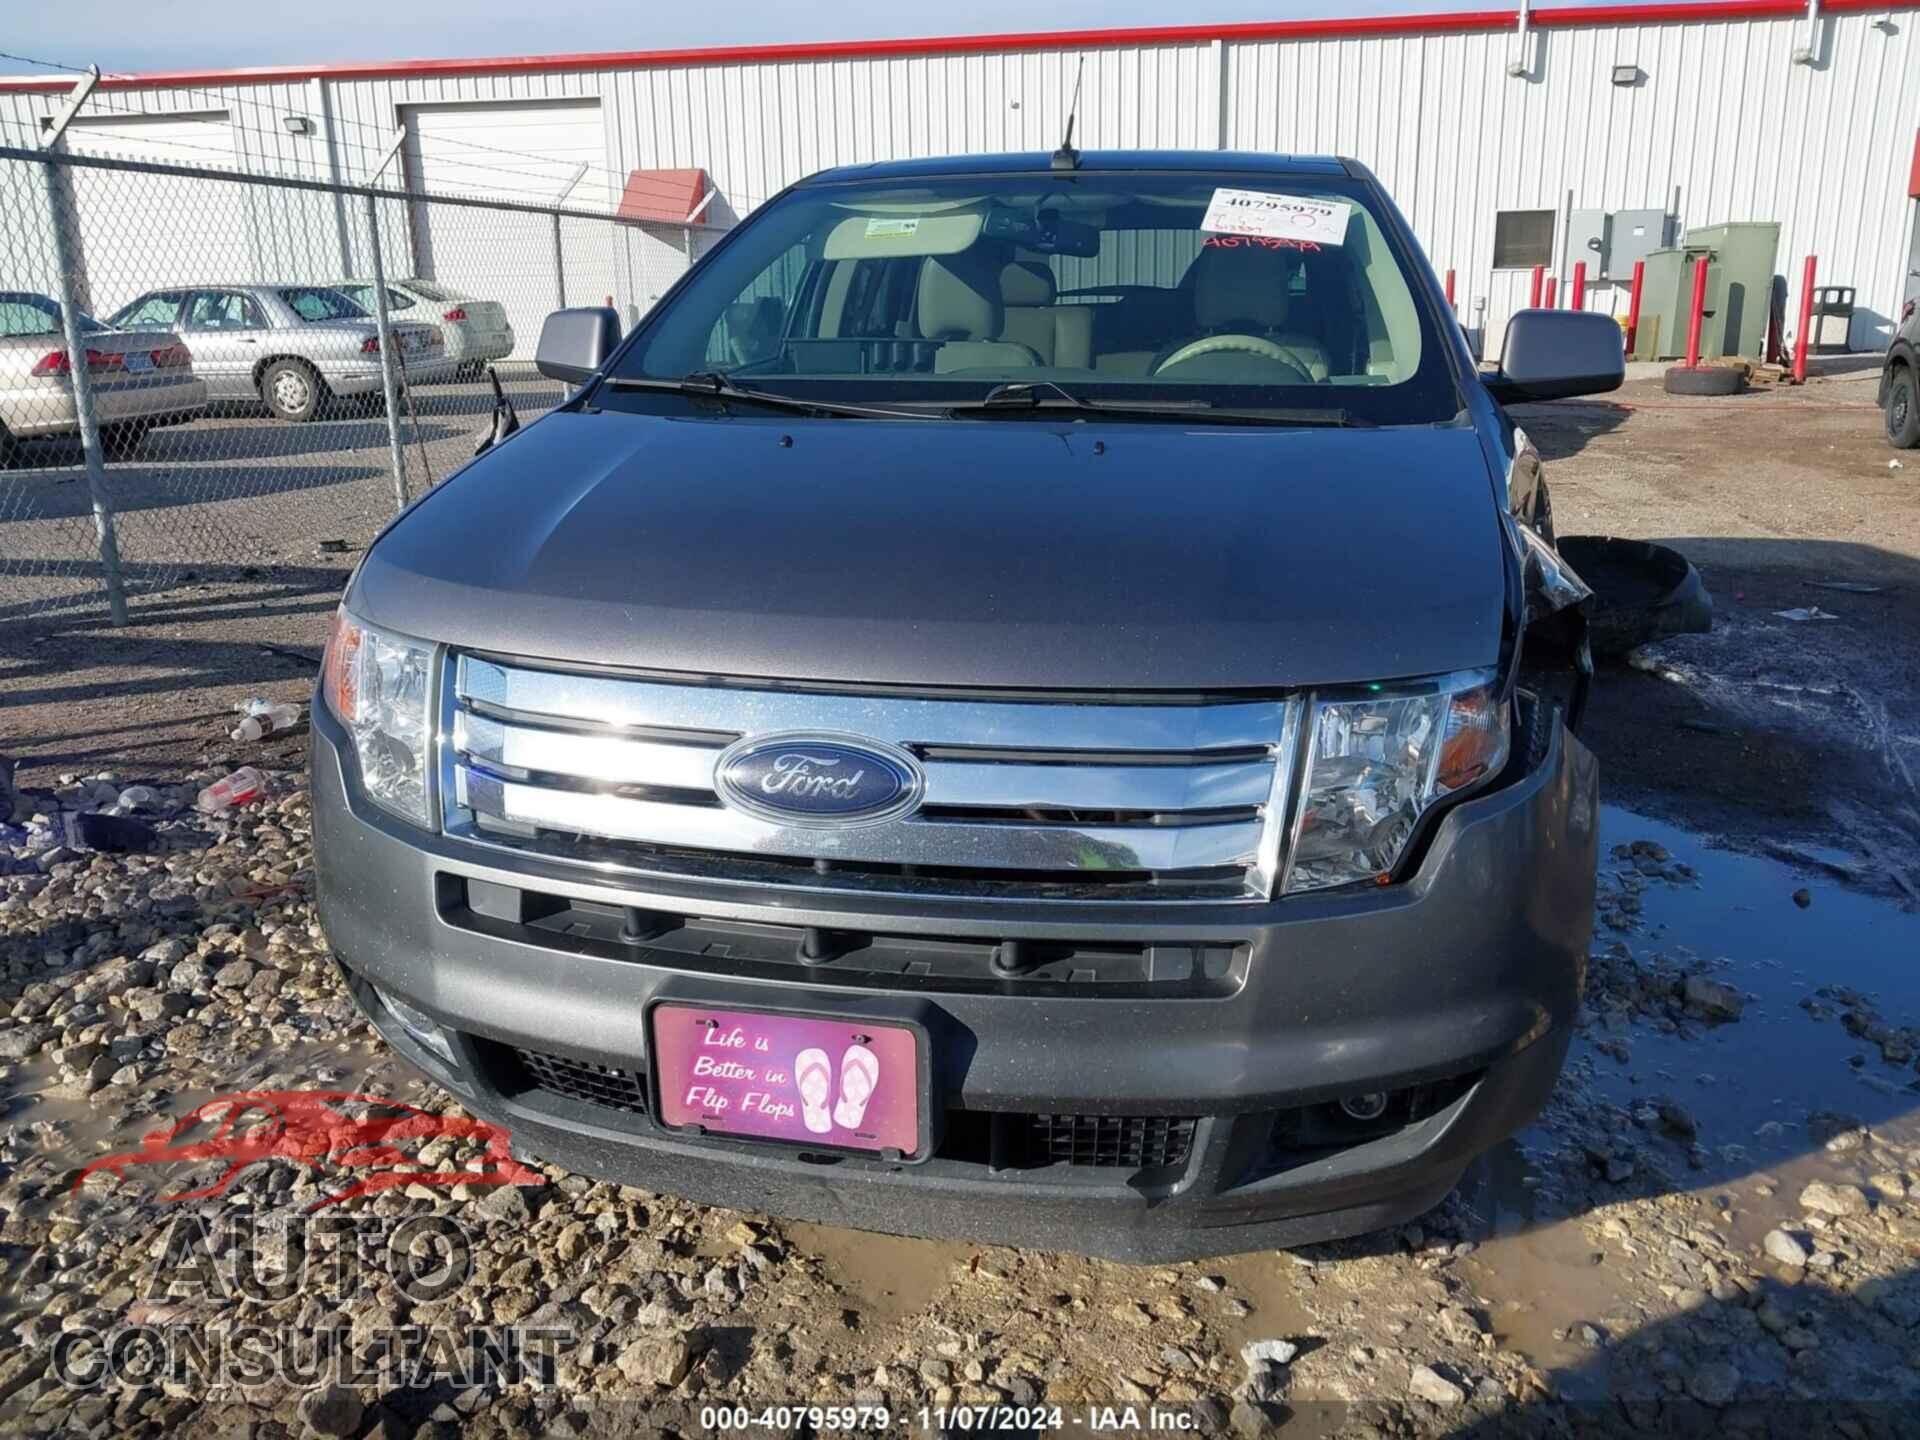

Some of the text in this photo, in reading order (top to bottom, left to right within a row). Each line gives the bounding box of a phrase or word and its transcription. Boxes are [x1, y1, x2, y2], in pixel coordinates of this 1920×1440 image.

[1226, 197, 1332, 216] 40795979
[761, 753, 865, 799] Ford
[704, 1028, 769, 1051] Life is
[694, 1056, 787, 1083] Better in
[686, 1087, 795, 1120] Flip Flops
